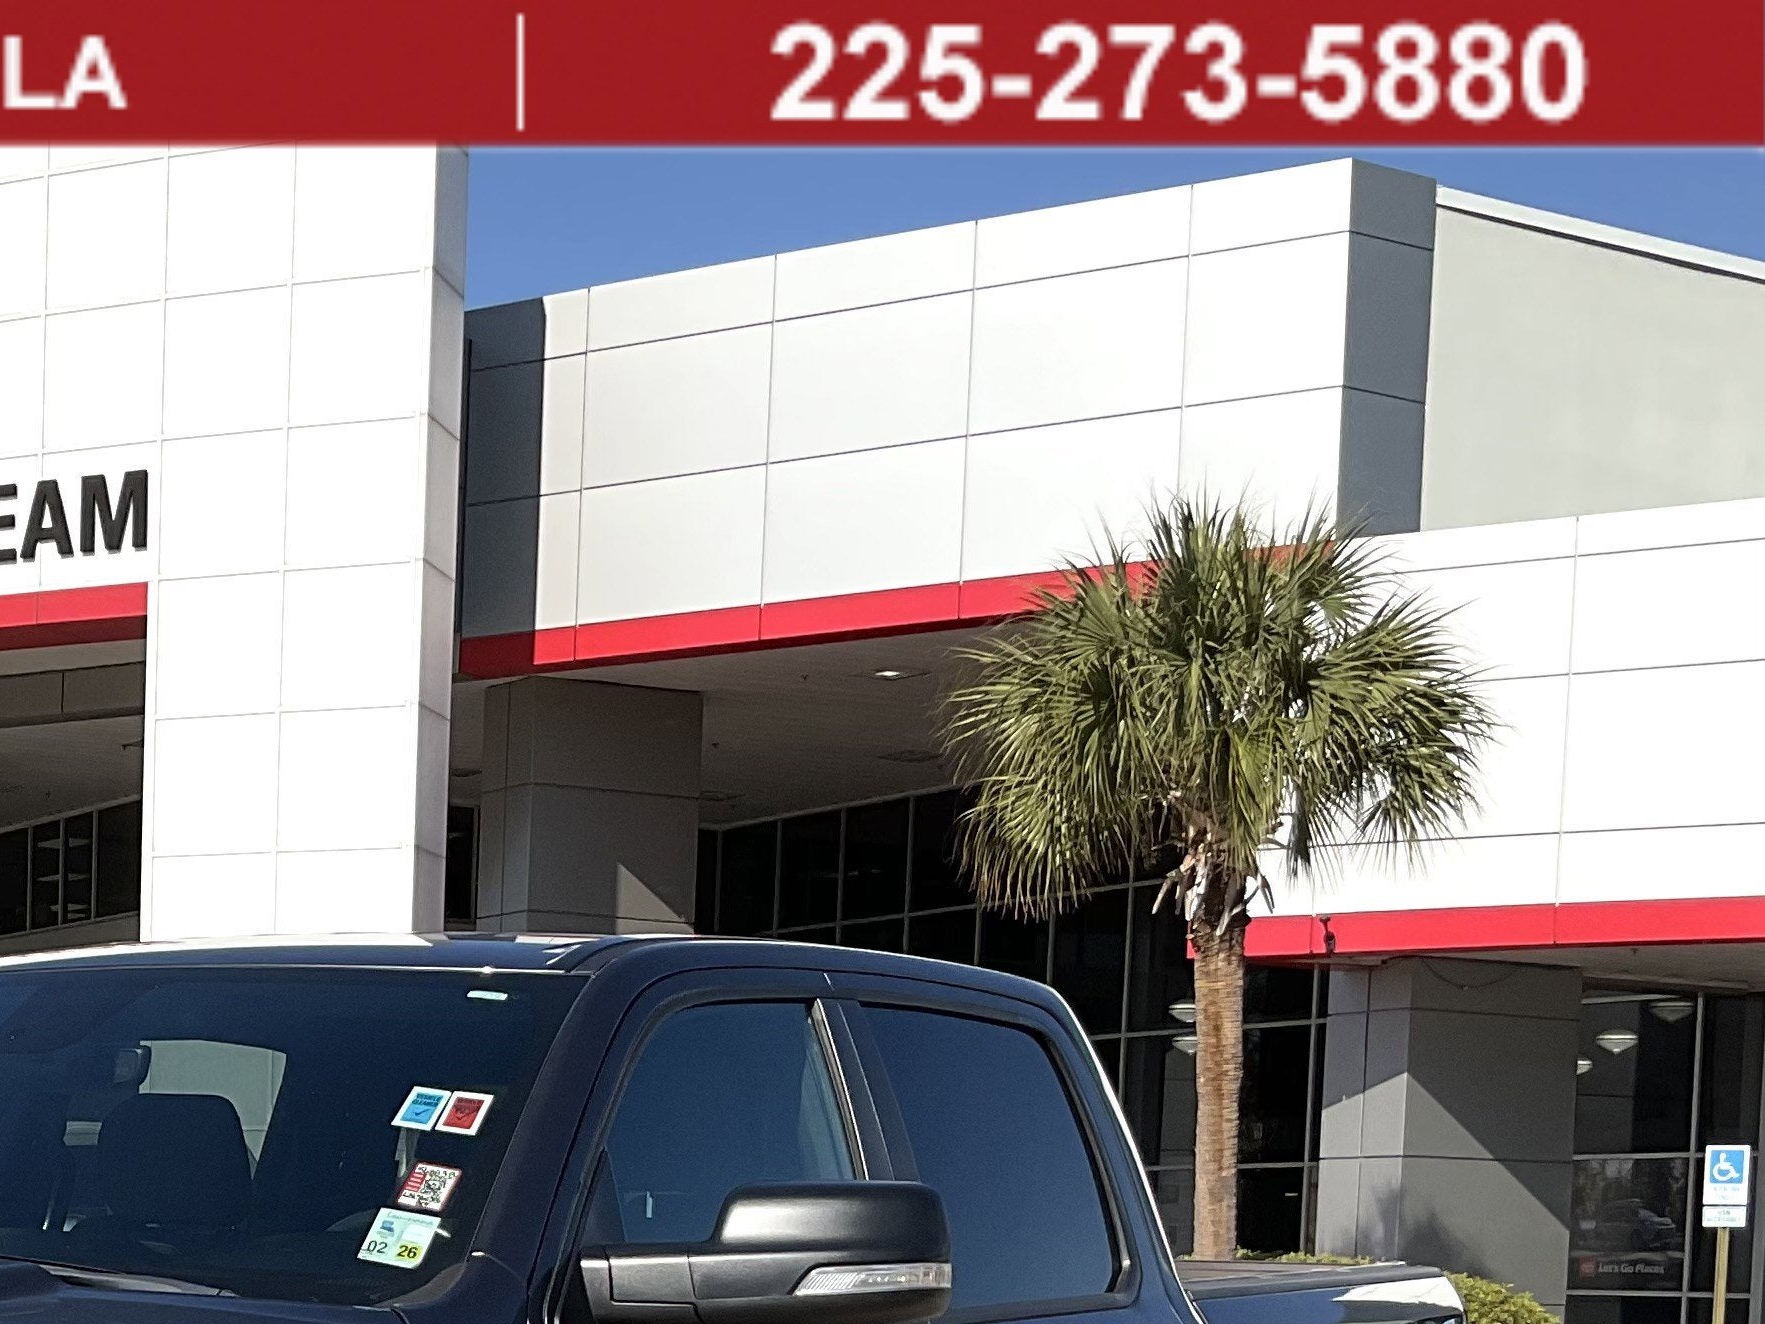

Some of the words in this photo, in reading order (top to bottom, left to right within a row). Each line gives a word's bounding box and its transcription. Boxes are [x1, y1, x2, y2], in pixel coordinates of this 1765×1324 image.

[366, 1240, 388, 1254] 02
[397, 1244, 419, 1259] 26
[1620, 1263, 1634, 1273] Go
